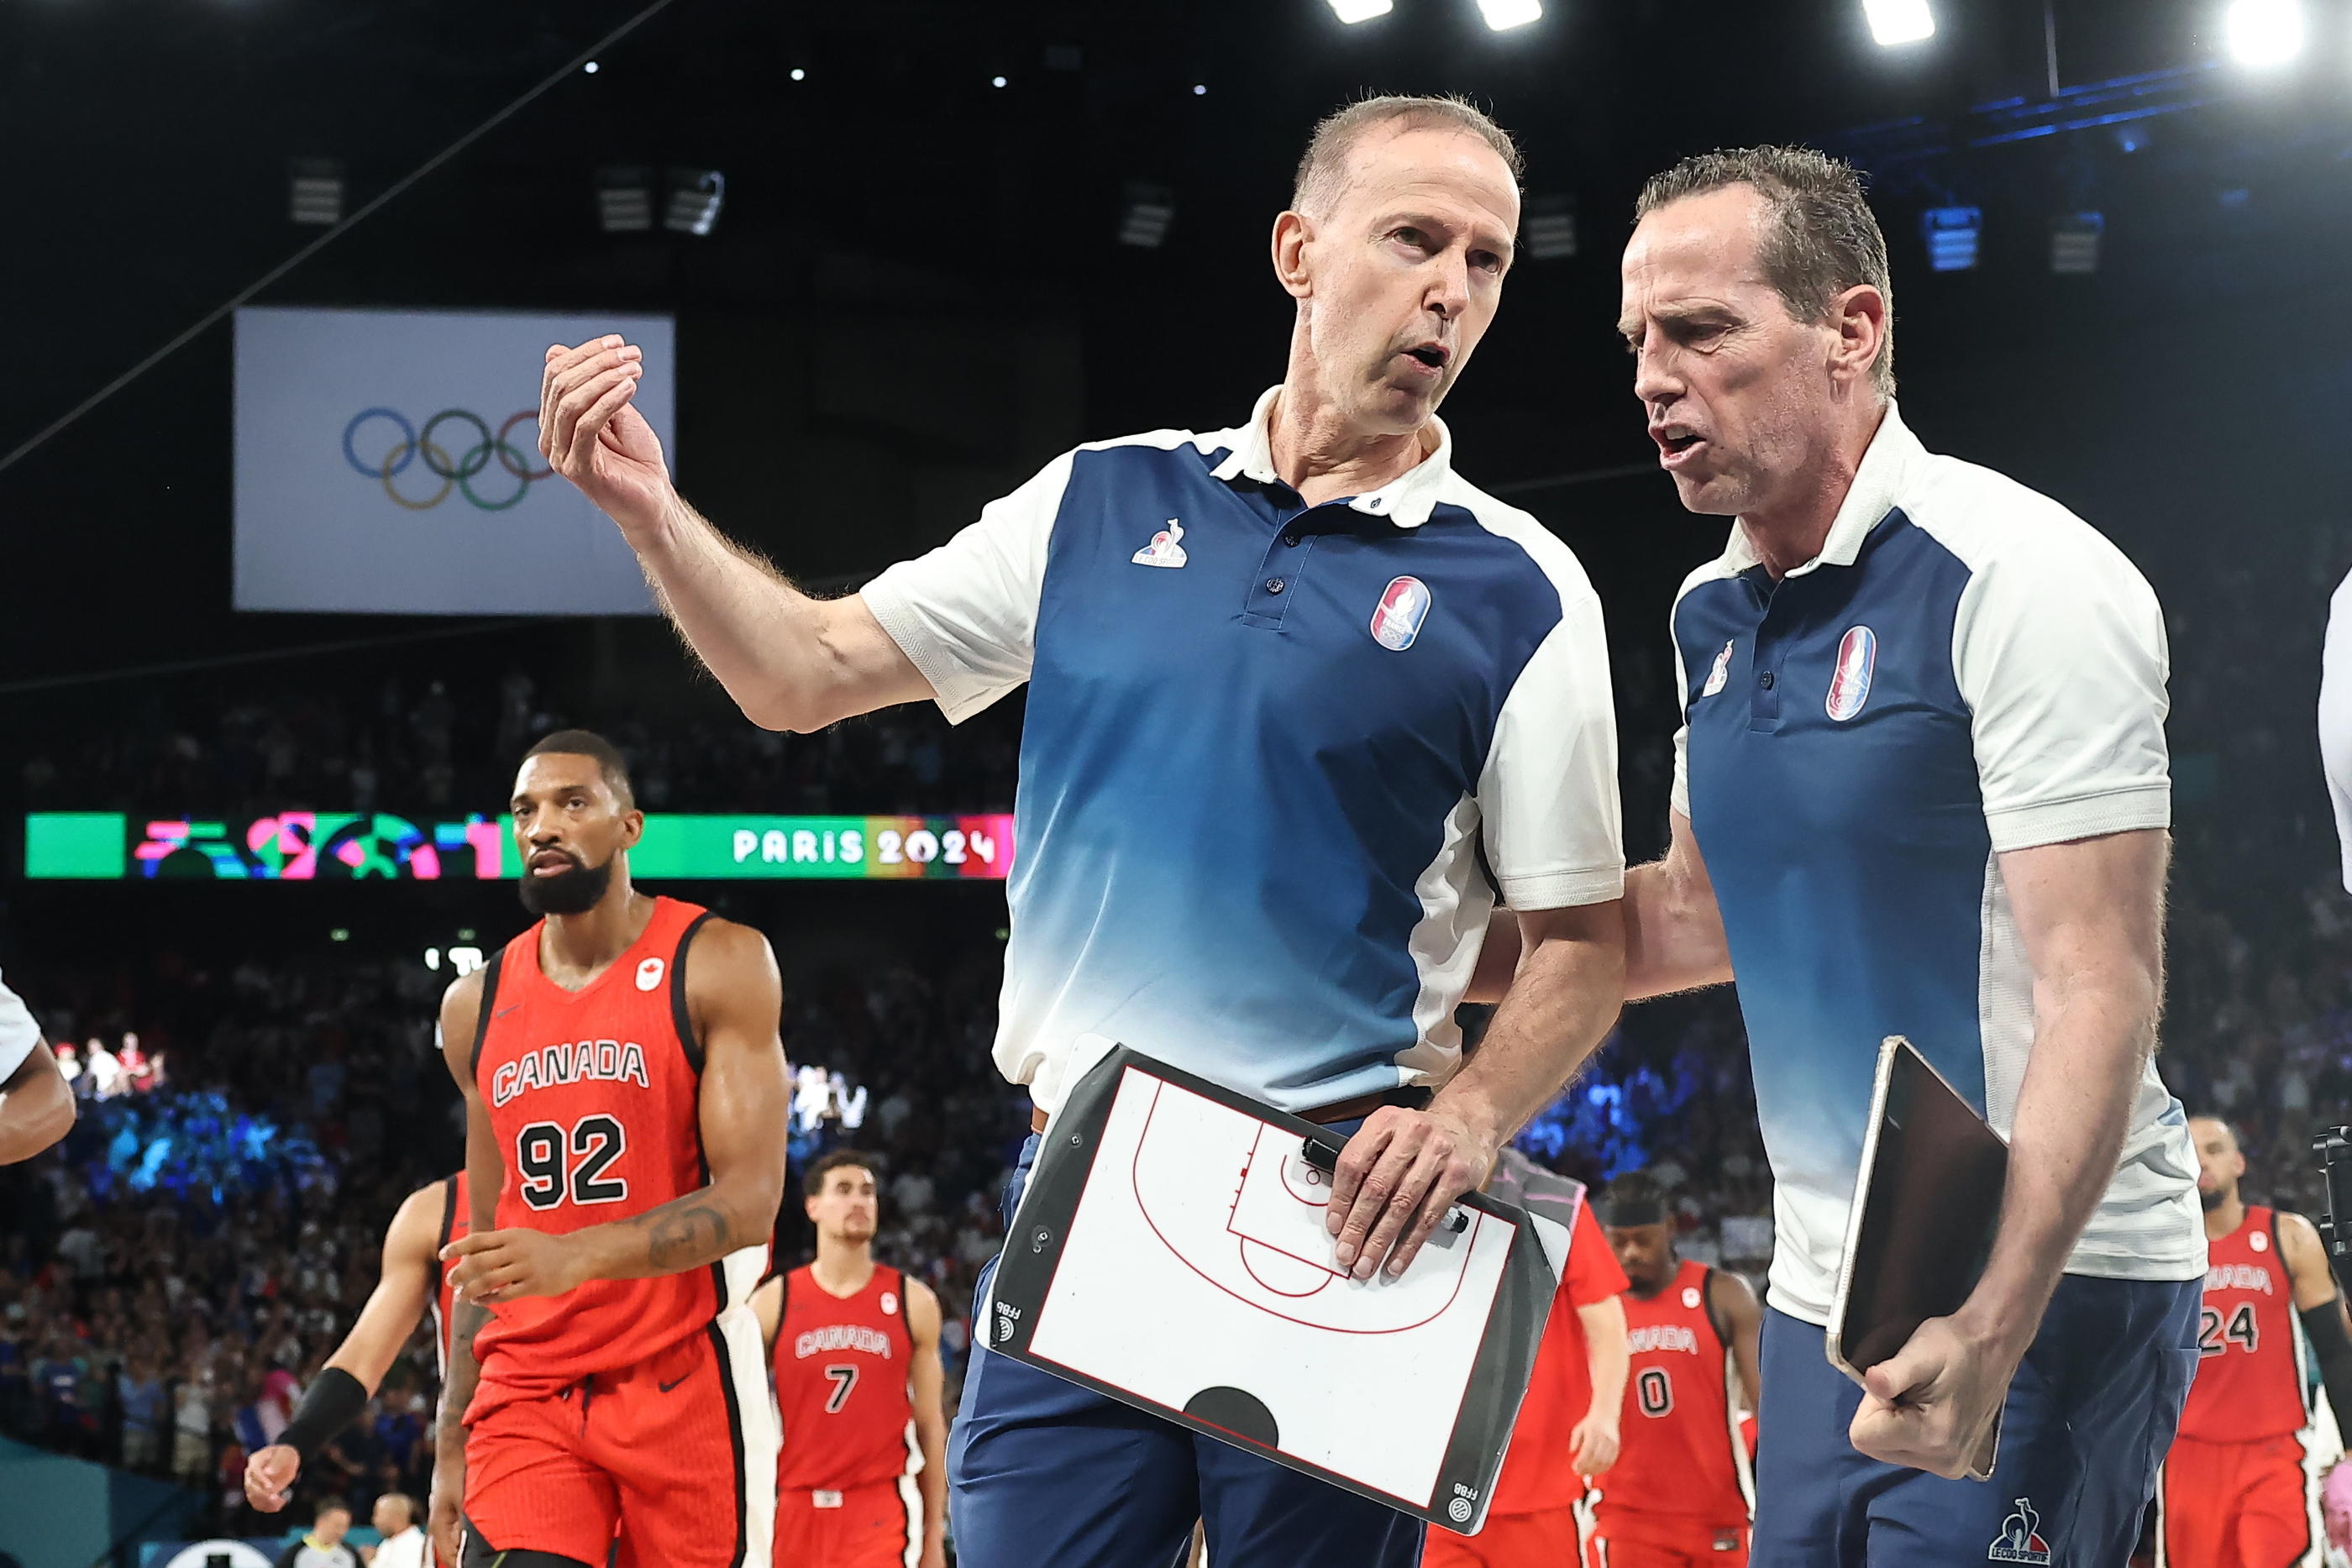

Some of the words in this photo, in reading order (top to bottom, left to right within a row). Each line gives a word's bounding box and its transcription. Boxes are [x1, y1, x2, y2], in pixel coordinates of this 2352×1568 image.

[877, 830, 995, 864] 2024
[492, 1039, 650, 1108] CANADA
[517, 1113, 627, 1212] 92
[795, 1325, 890, 1359] CANADA
[2199, 1301, 2260, 1358] 24
[824, 1364, 859, 1413] 7
[1635, 1366, 1675, 1419] 0
[1454, 1482, 1478, 1501] FFBB
[1992, 1548, 2000, 1558] LE
